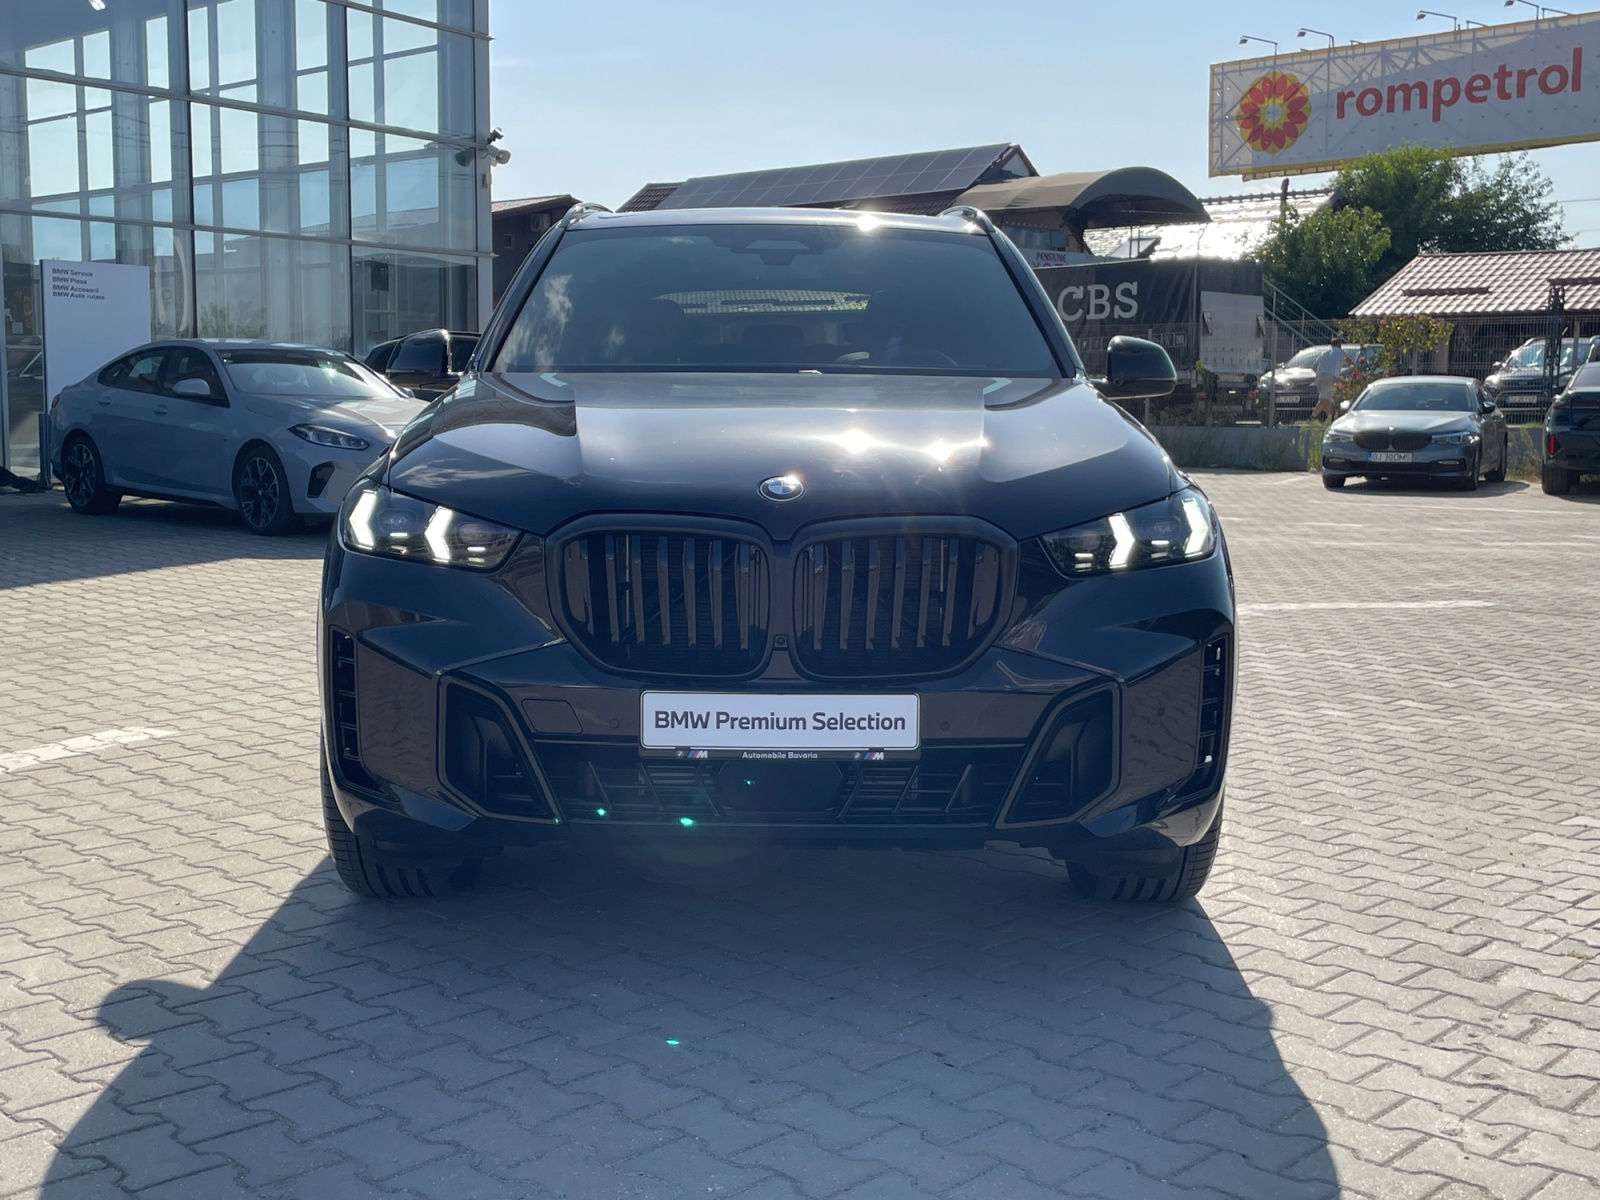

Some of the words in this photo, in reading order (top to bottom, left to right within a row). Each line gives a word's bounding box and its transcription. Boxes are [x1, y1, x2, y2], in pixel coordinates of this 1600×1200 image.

[1336, 47, 1583, 122] rompetrol
[70, 269, 93, 277] Service
[70, 277, 87, 285] Piese
[70, 285, 99, 293] Accesorii
[1057, 281, 1139, 322] CBS
[655, 710, 710, 729] BMW
[716, 711, 806, 730] Premium
[812, 711, 906, 731] Selection
[742, 751, 786, 759] Automobile
[788, 751, 818, 759] Bavaria
